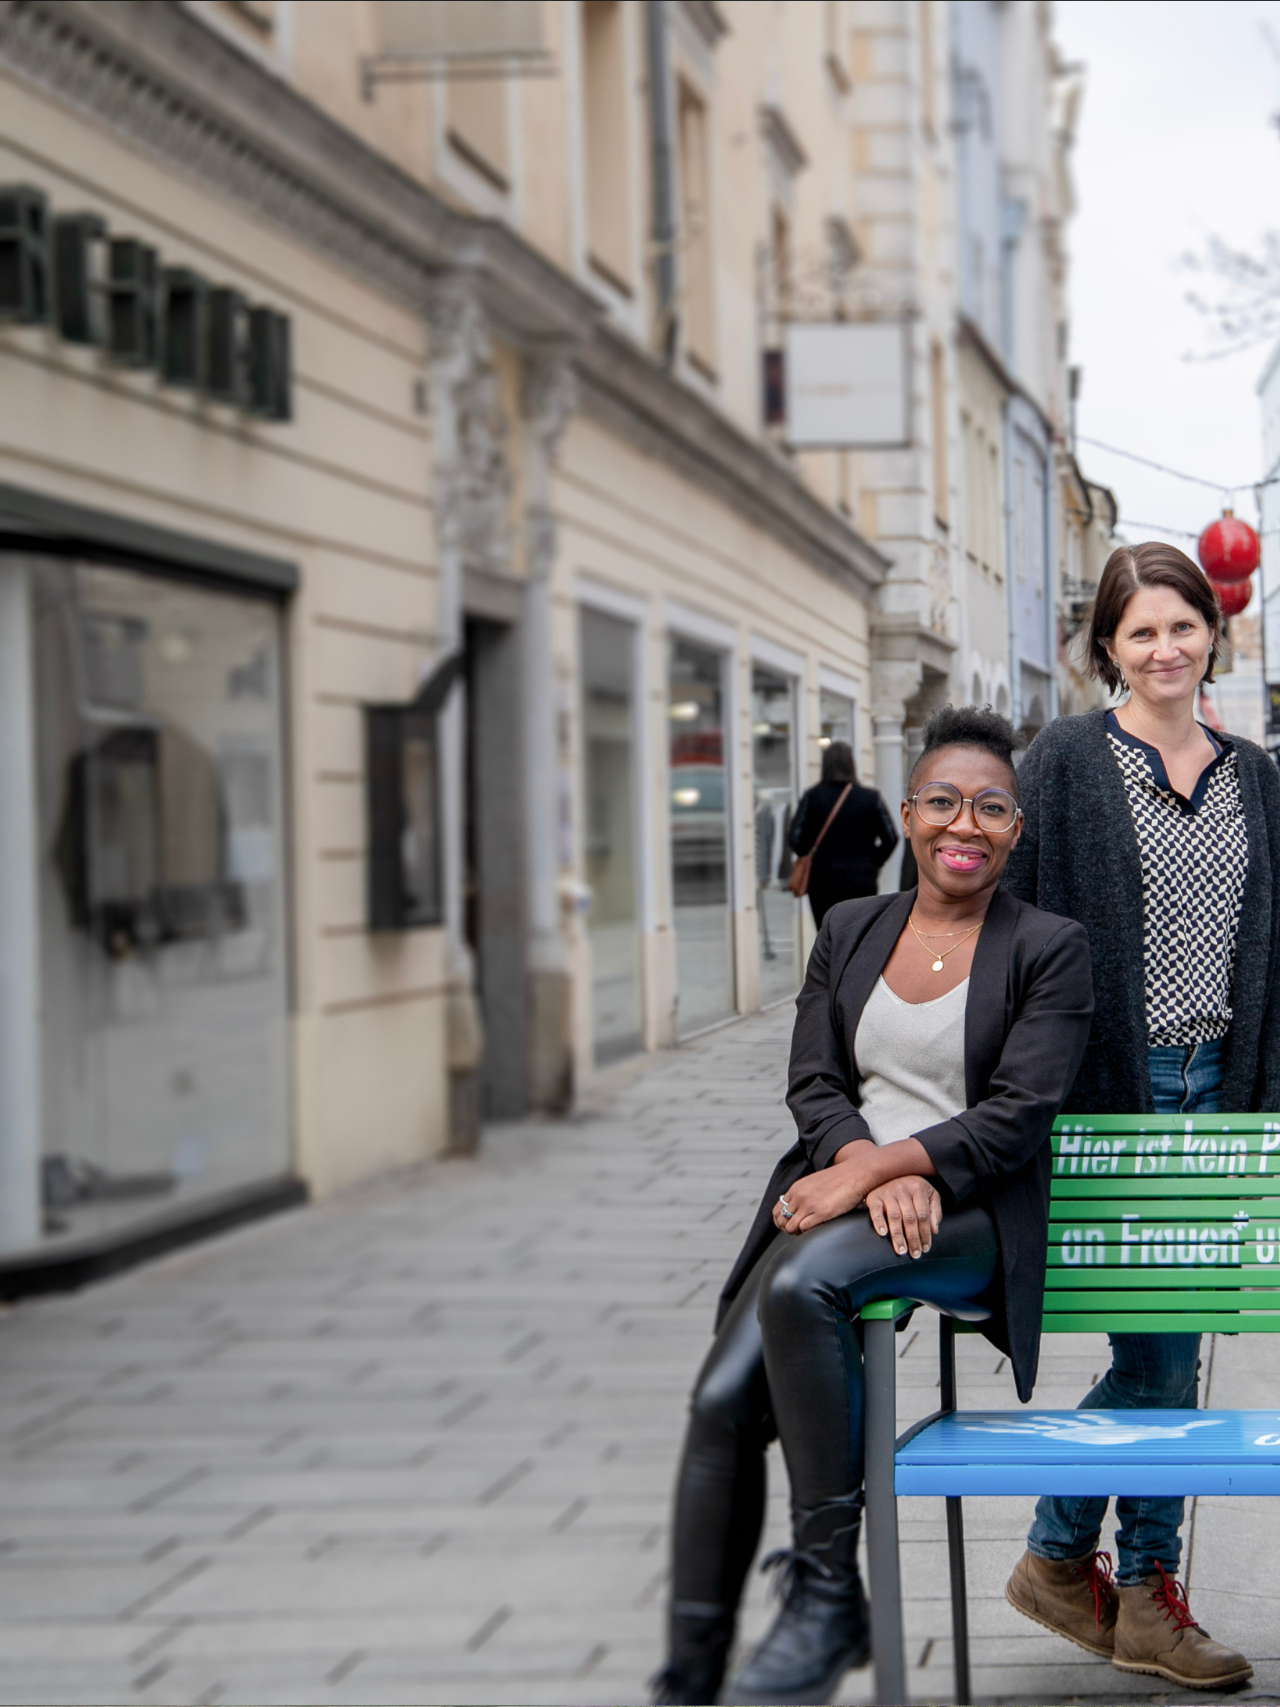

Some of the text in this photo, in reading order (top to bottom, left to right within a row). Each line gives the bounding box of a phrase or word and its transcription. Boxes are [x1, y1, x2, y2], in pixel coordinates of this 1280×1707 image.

[1057, 1125, 1127, 1173] Hier
[1134, 1128, 1172, 1173] ist
[1181, 1120, 1247, 1173] kein
[1061, 1228, 1105, 1264] an
